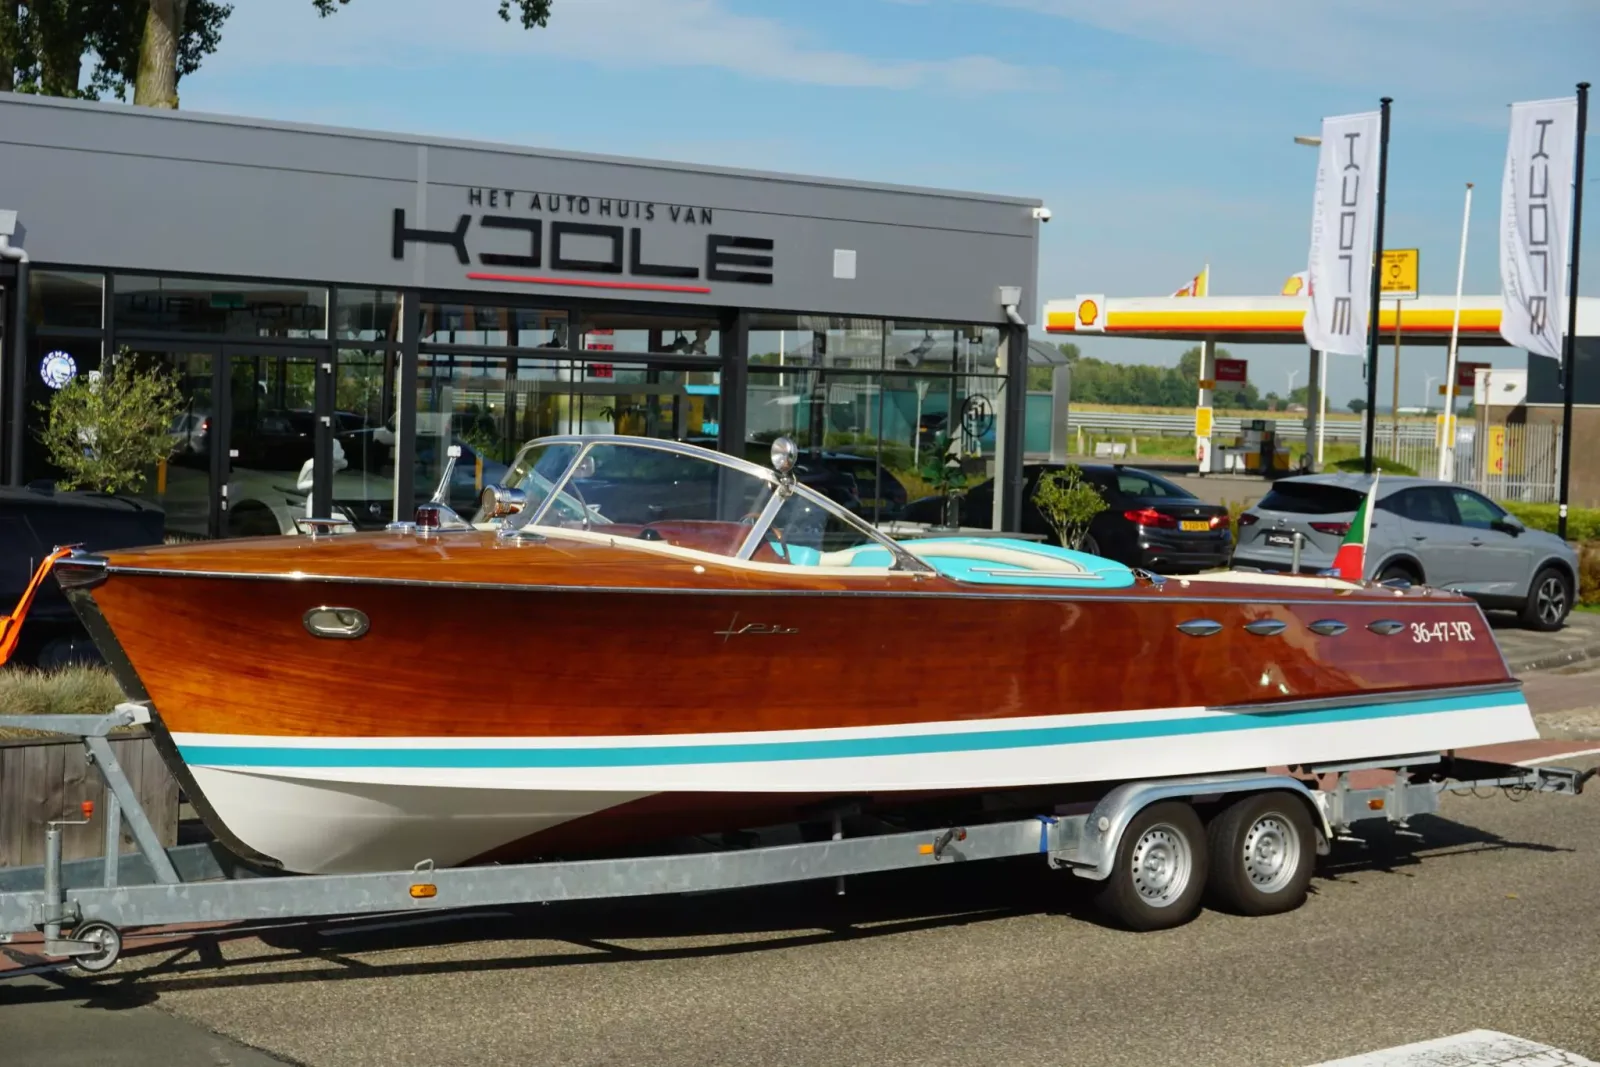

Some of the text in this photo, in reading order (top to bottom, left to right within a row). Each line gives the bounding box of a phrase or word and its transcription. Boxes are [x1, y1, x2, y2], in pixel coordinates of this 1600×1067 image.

[468, 187, 516, 208] HET
[668, 204, 714, 226] VAN
[392, 208, 774, 285] KOOLE
[1410, 621, 1476, 644] 36-47-YR
